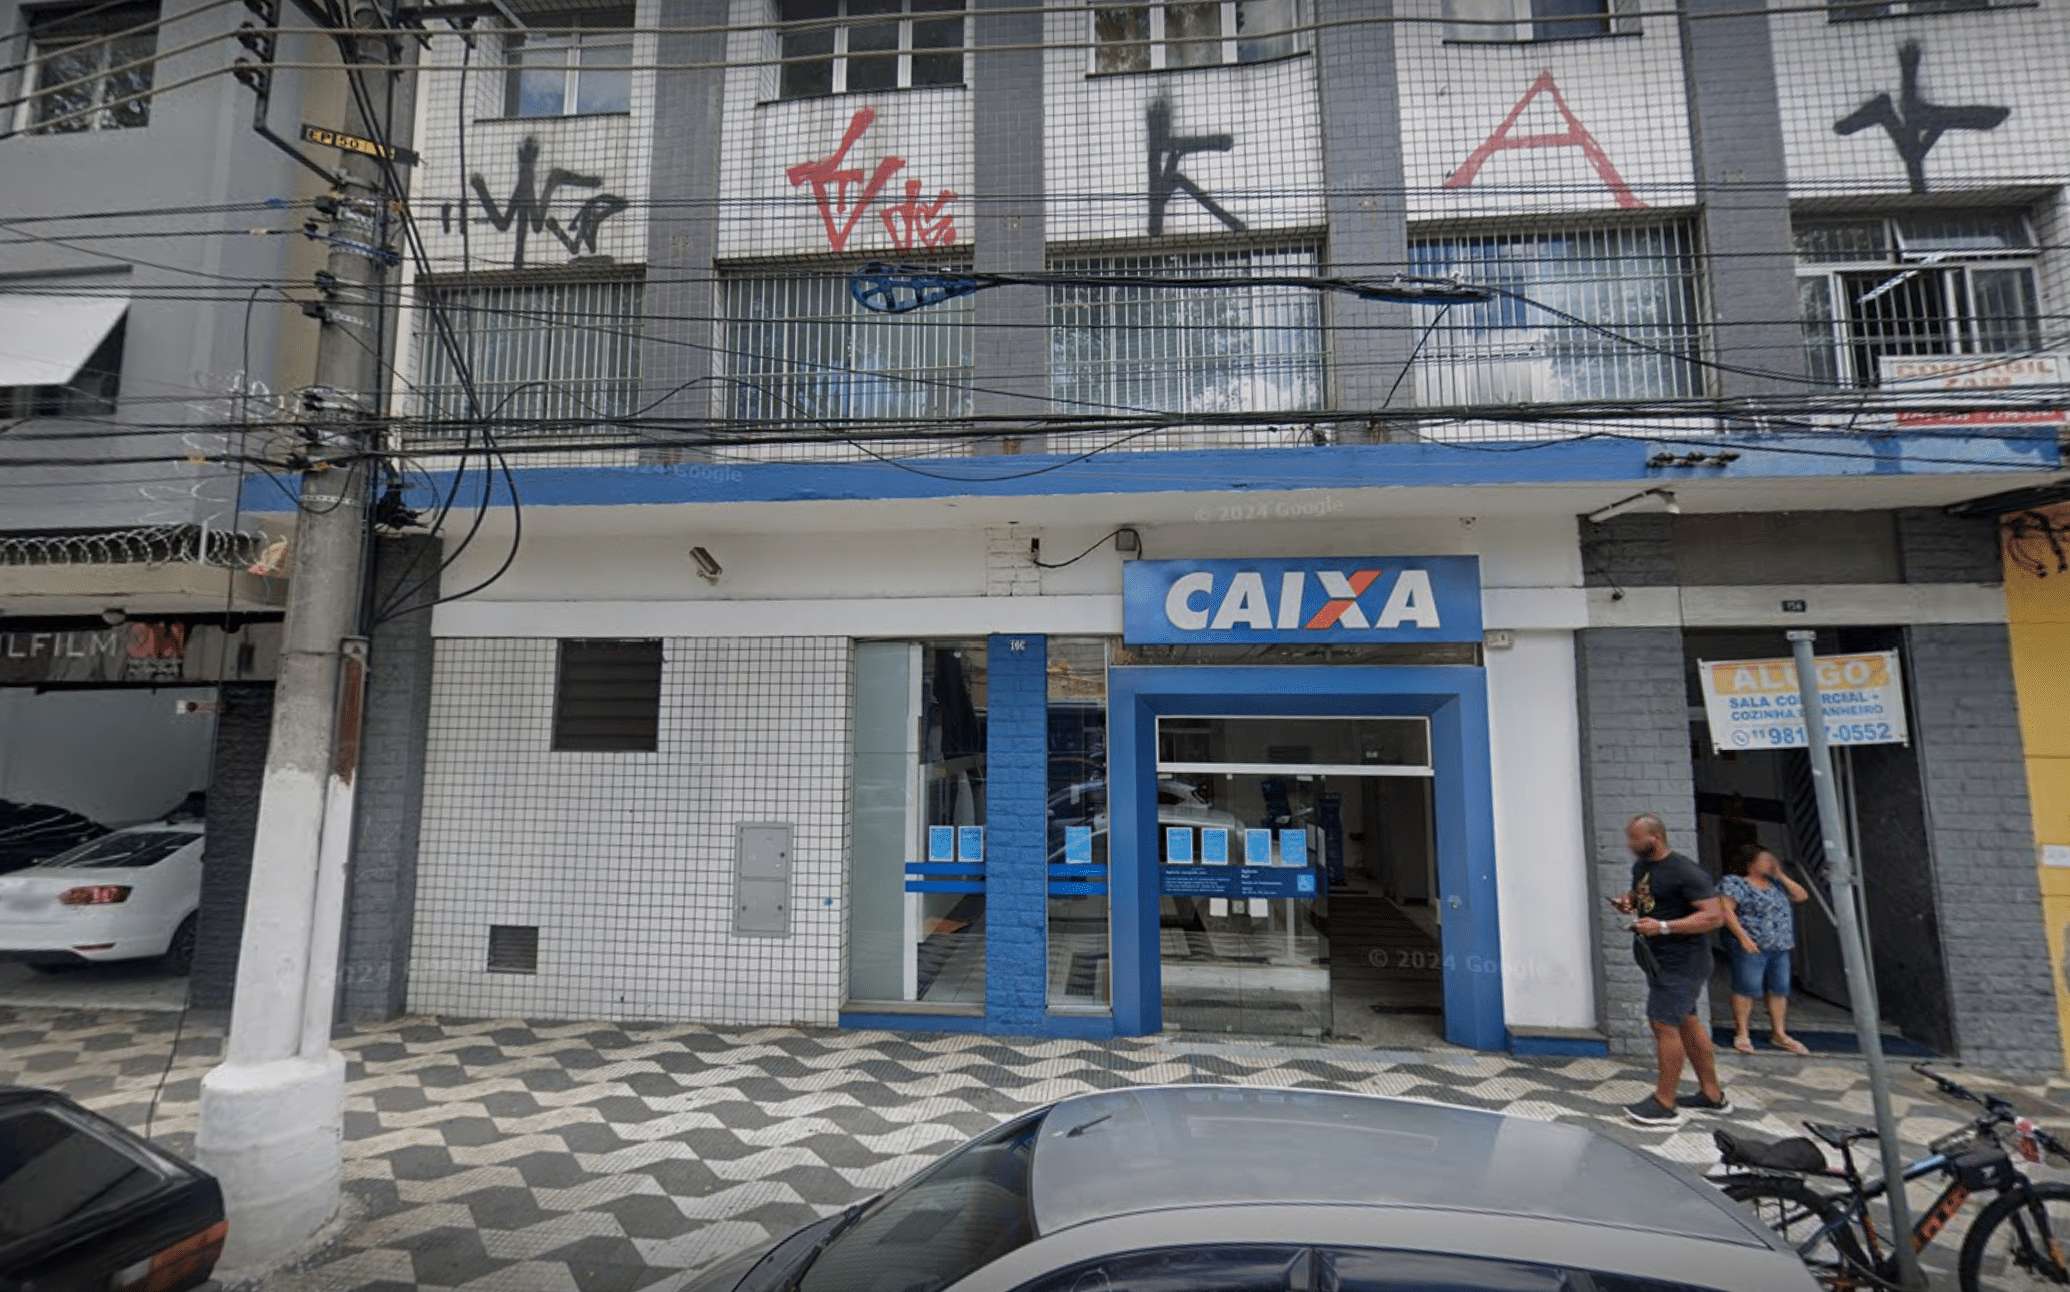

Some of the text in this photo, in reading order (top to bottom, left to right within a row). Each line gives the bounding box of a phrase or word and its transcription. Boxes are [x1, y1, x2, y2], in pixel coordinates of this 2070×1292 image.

[1165, 569, 1441, 630] CAIXA
[0, 631, 118, 657] LFILM
[1729, 696, 1771, 709] SALA
[1776, 692, 1868, 707] CORCIAL
[1731, 709, 1796, 721] COZINHA
[1820, 705, 1884, 717] ANHEIRO
[1768, 722, 1893, 745] 981-0552
